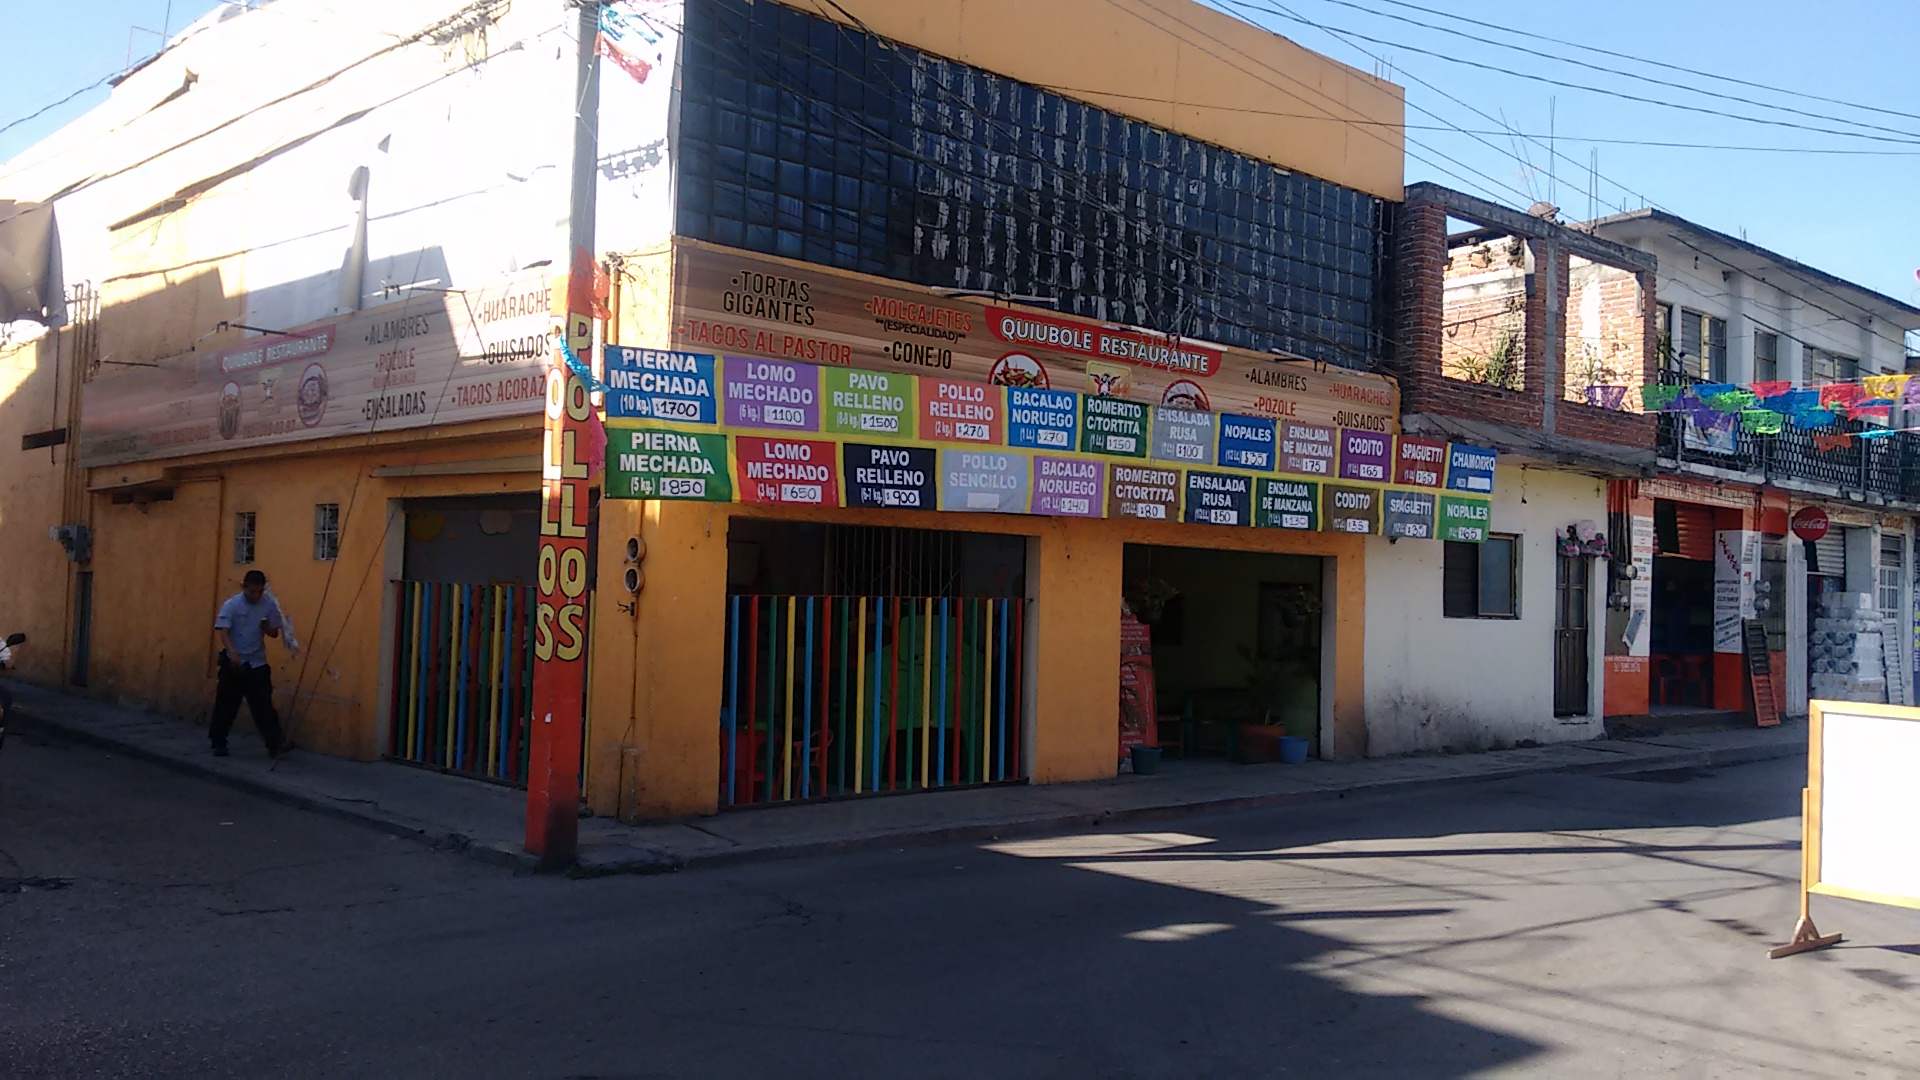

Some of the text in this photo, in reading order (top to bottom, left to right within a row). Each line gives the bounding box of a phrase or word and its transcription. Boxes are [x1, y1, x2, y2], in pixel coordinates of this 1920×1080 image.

[741, 271, 810, 302] TORTAS
[484, 288, 551, 323] HUARACHE
[723, 291, 815, 326] GIGANTES
[872, 296, 973, 332] MOLCAJETES
[369, 314, 429, 345] ALAMBRES
[488, 331, 551, 365] GUISADOS
[688, 320, 852, 365] TACOS AL PASTOR
[1001, 317, 1209, 373] QUIUBOLE RESTAURANTE
[379, 347, 415, 372] POZOLE
[621, 349, 698, 374] PIERNA
[893, 341, 952, 370] CONEJO
[747, 362, 796, 383] LOMO
[849, 373, 889, 391] PAVO
[1250, 368, 1308, 392] ALAMBRES
[457, 374, 546, 407] TACOS ACORAZ
[610, 369, 710, 397] MECHADA
[938, 383, 985, 402] POLLO
[728, 382, 813, 405] MECHADO
[833, 391, 904, 412] RELLENO
[1013, 391, 1073, 410] BACALAO
[1333, 382, 1391, 407] HUARACHES
[366, 390, 426, 421] ENSALADAS
[620, 394, 635, 414] (10
[655, 401, 698, 417] $1700
[929, 401, 995, 422] RELLENO
[1087, 398, 1142, 418] ROMERITO
[1258, 396, 1297, 417] POZOLE
[863, 415, 898, 430] $1500
[1011, 408, 1074, 428] NORUEGO
[1086, 416, 1140, 435] C/TORTITA
[1158, 408, 1211, 427] ENSALADA
[1337, 410, 1386, 432] GUISADOS
[958, 424, 984, 438] $270
[1169, 426, 1198, 441] RUSA
[1224, 424, 1272, 442] NOPALES
[1288, 425, 1330, 442] ENSALADA
[631, 432, 701, 453] PIERNA
[764, 442, 811, 461] LOMO
[1178, 445, 1199, 458] $100
[1283, 441, 1334, 458] DE MANZANA
[1348, 437, 1384, 457] CODITO
[870, 449, 910, 466] PAVO
[962, 454, 1008, 471] POLLO
[1402, 443, 1443, 463] SPAGUETTI
[1452, 452, 1496, 471] CHAMORRO
[620, 453, 715, 475] MECHADA
[747, 462, 829, 482] MECHADO
[1042, 461, 1096, 478] BACALAO
[630, 476, 640, 495] (5
[662, 479, 703, 495] $850
[856, 468, 925, 486] RELLENO
[949, 472, 1017, 490] SENCILLO
[1115, 467, 1176, 486] ROMERITO
[1189, 475, 1246, 493] ENSALADA
[556, 311, 594, 663] POLLOS
[783, 485, 817, 500] $650
[1039, 478, 1096, 496] NORUEGO
[1115, 484, 1175, 503] C/TORTITA
[1267, 481, 1309, 498] ENSALADA
[886, 490, 916, 505] $900
[1202, 492, 1232, 508] RUSA
[1262, 496, 1313, 513] DE MANZANA
[1335, 491, 1371, 510] CODITO
[1390, 498, 1432, 516] SPAGUETTI
[1446, 503, 1489, 520] NOPALES
